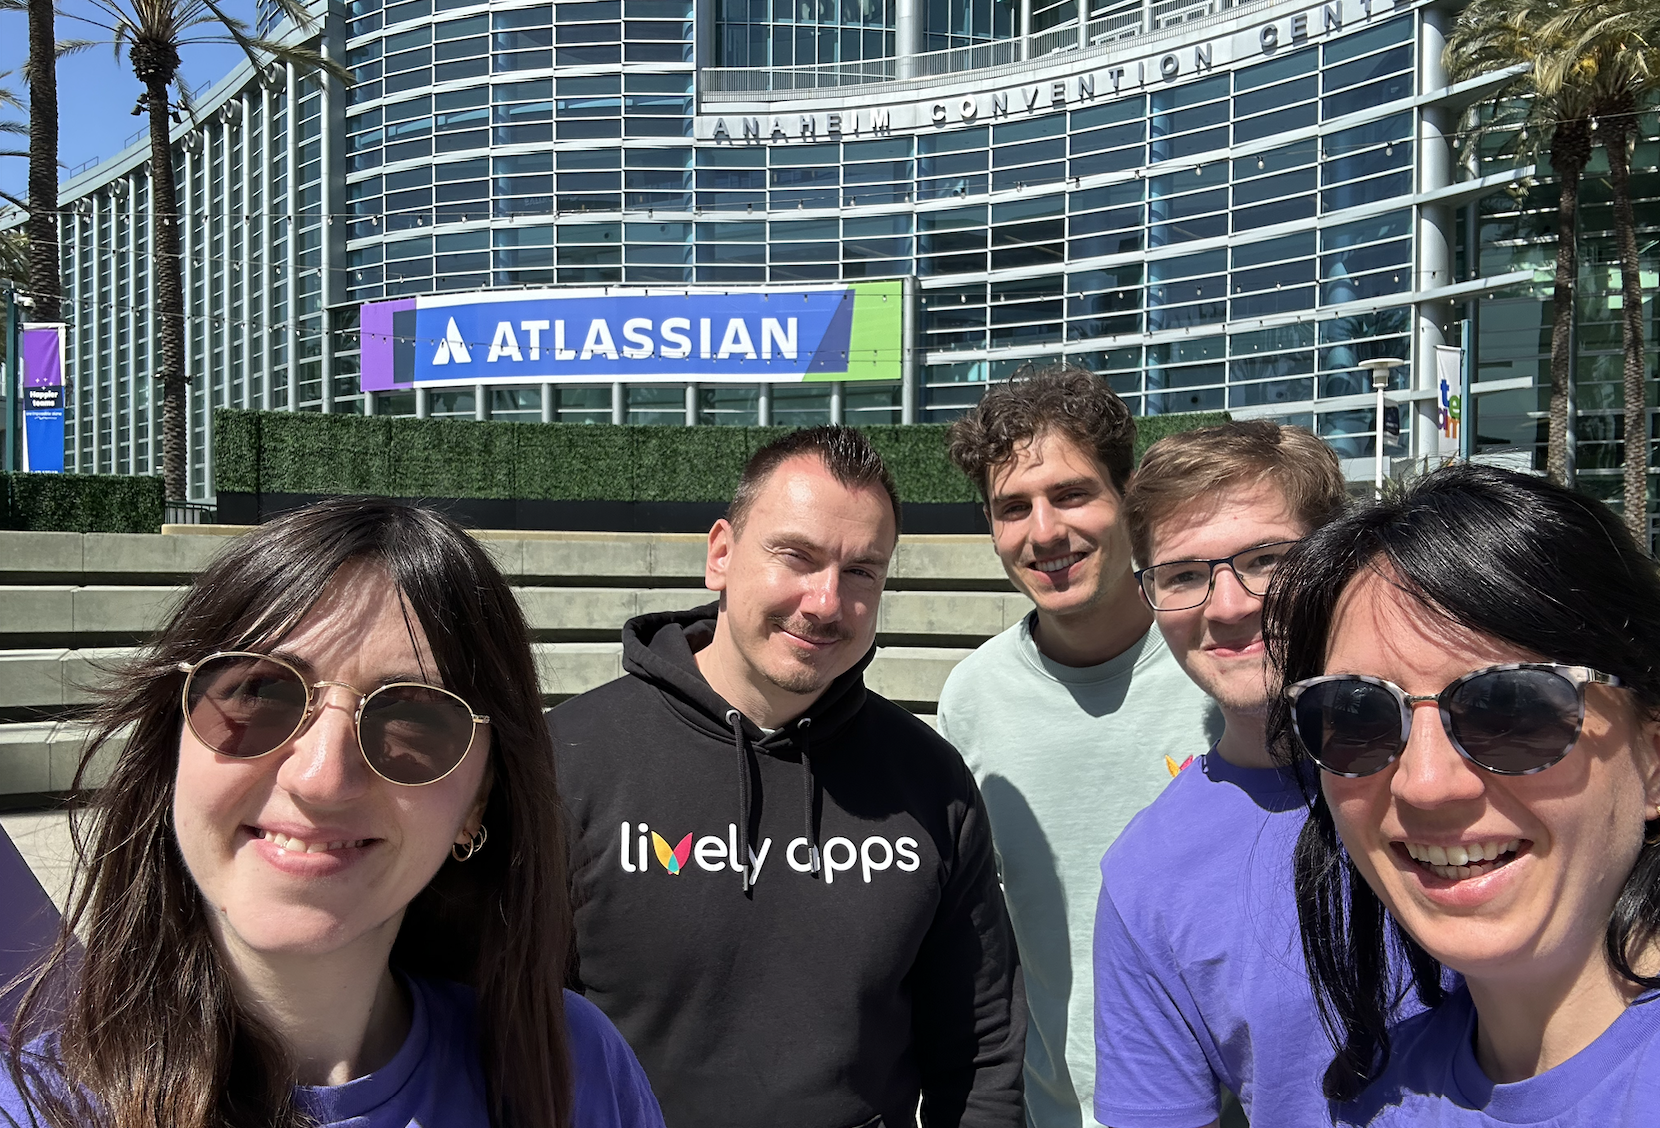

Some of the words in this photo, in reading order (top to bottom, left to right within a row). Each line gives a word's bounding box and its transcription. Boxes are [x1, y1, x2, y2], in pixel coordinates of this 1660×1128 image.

[712, 108, 890, 137] ANAHEIM
[931, 43, 1213, 122] CONVENTION
[486, 317, 798, 362] ATLASSIAN
[29, 390, 59, 400] Happier
[621, 821, 772, 885] lively
[786, 836, 921, 884] apps
